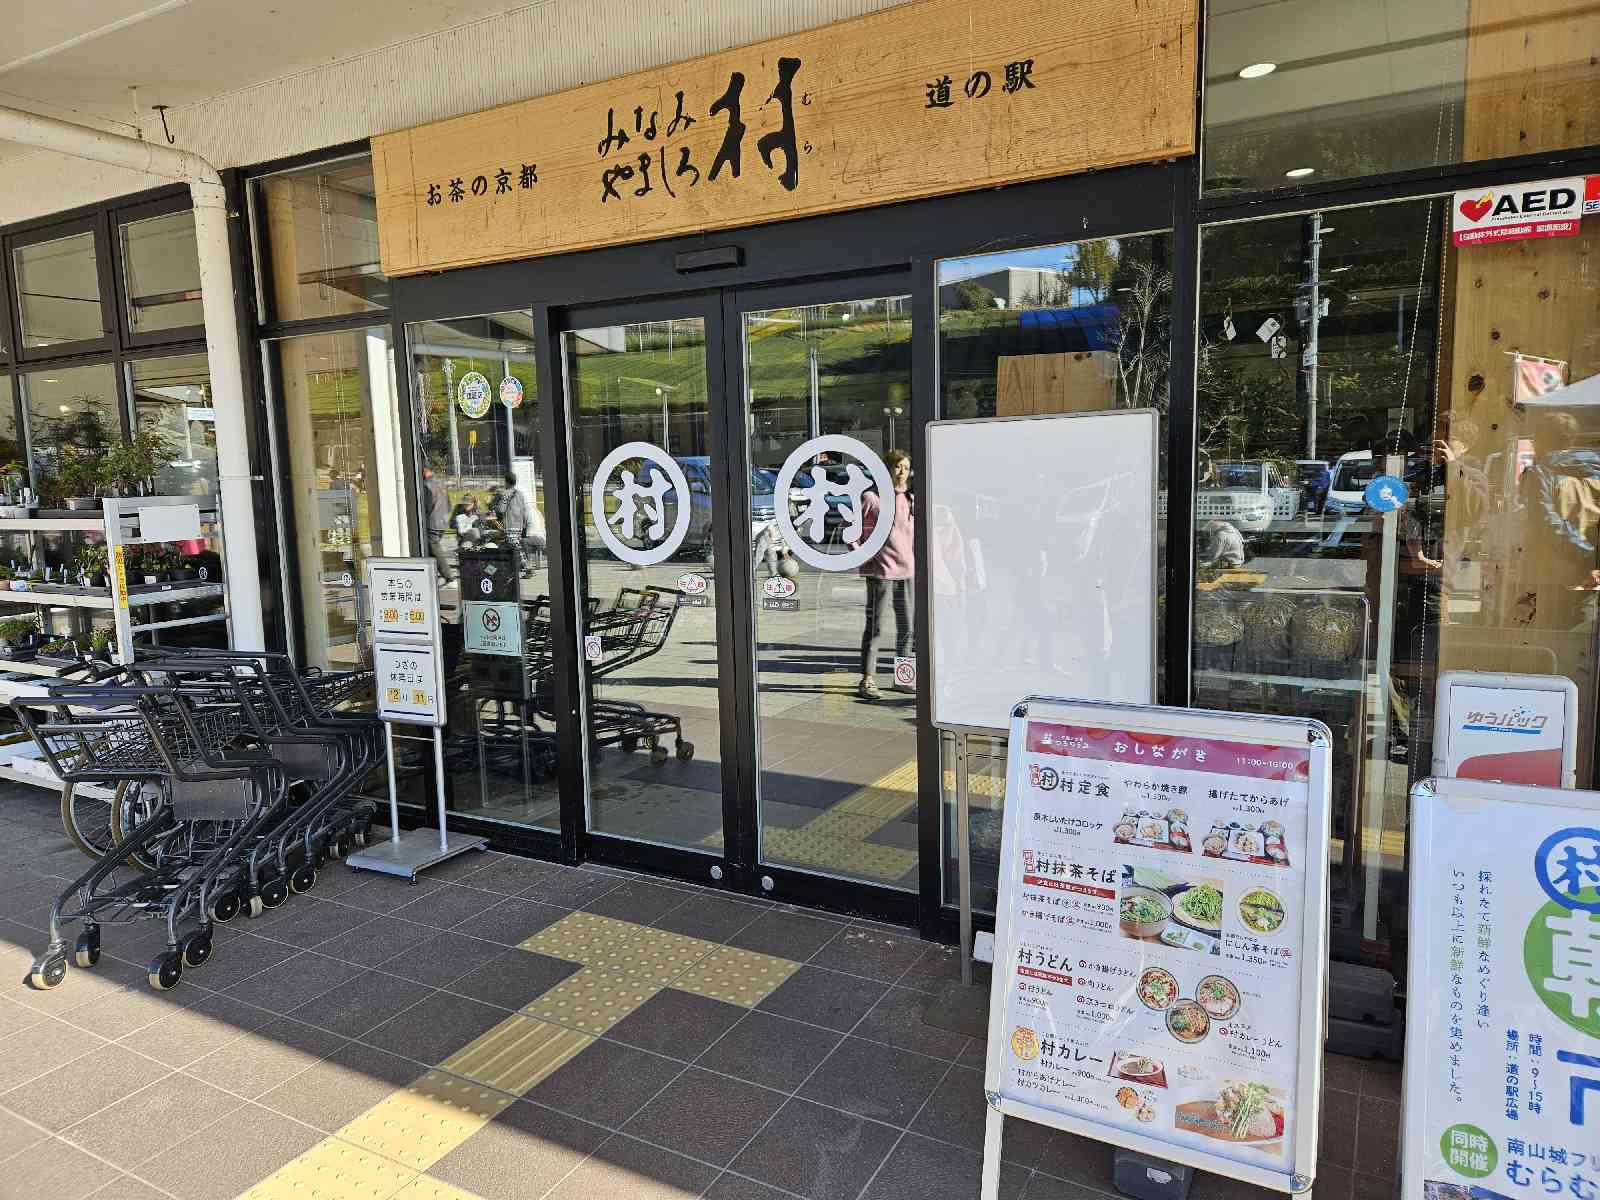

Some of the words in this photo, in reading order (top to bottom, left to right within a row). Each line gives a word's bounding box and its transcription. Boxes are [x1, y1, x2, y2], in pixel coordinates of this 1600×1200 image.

[925, 58, 1036, 108] 道の駅
[598, 91, 696, 158] みなみ
[708, 57, 801, 191] 村
[427, 164, 538, 206] お茶の京都
[601, 146, 701, 202] やましろ
[1492, 188, 1576, 216] AED
[1465, 711, 1549, 729] ゆうパック
[1114, 741, 1207, 762] おしながき
[1060, 777, 1110, 797] 村定食
[1036, 858, 1117, 883] 村抹茶そば
[1018, 947, 1073, 972] 村うどん
[1040, 1039, 1103, 1063] 村カレー
[1451, 1130, 1488, 1153] 同時
[1450, 1148, 1489, 1172] 開催
